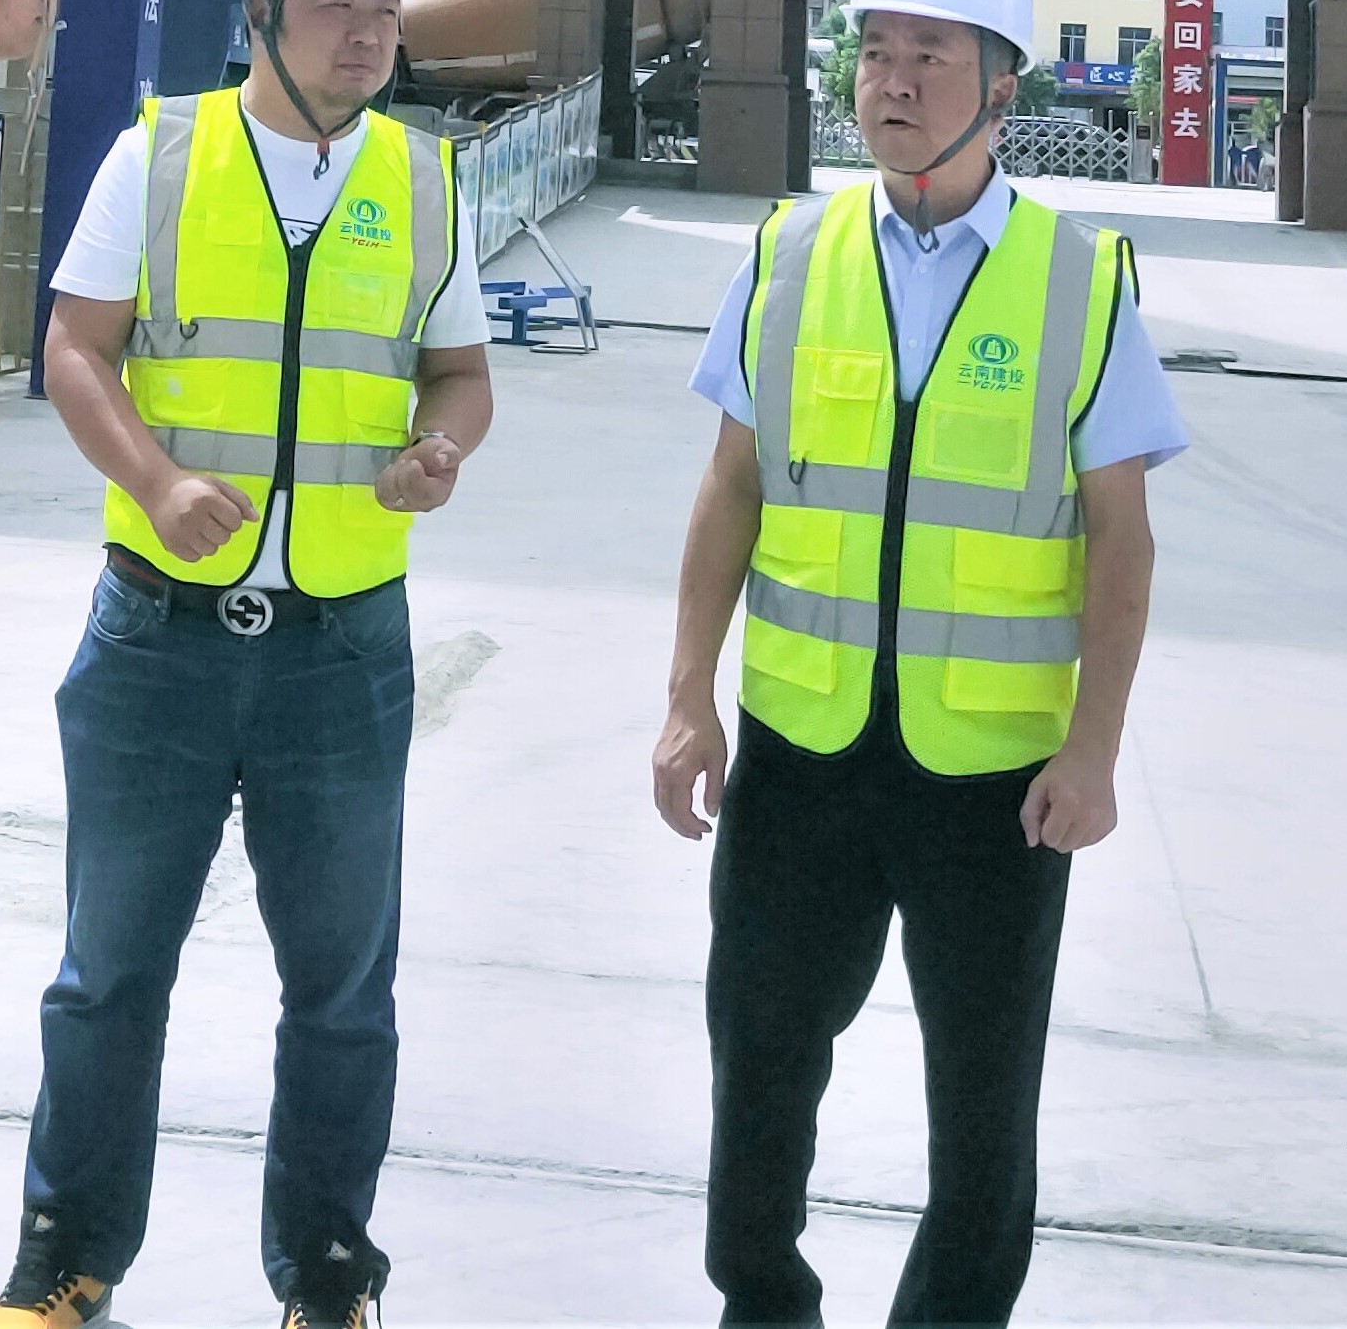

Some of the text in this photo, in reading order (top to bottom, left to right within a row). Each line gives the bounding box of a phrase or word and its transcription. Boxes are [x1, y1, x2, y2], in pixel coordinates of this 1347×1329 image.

[351, 237, 380, 249] YCIH
[957, 363, 1025, 384] 云南建投
[973, 379, 1008, 391] YCIH
